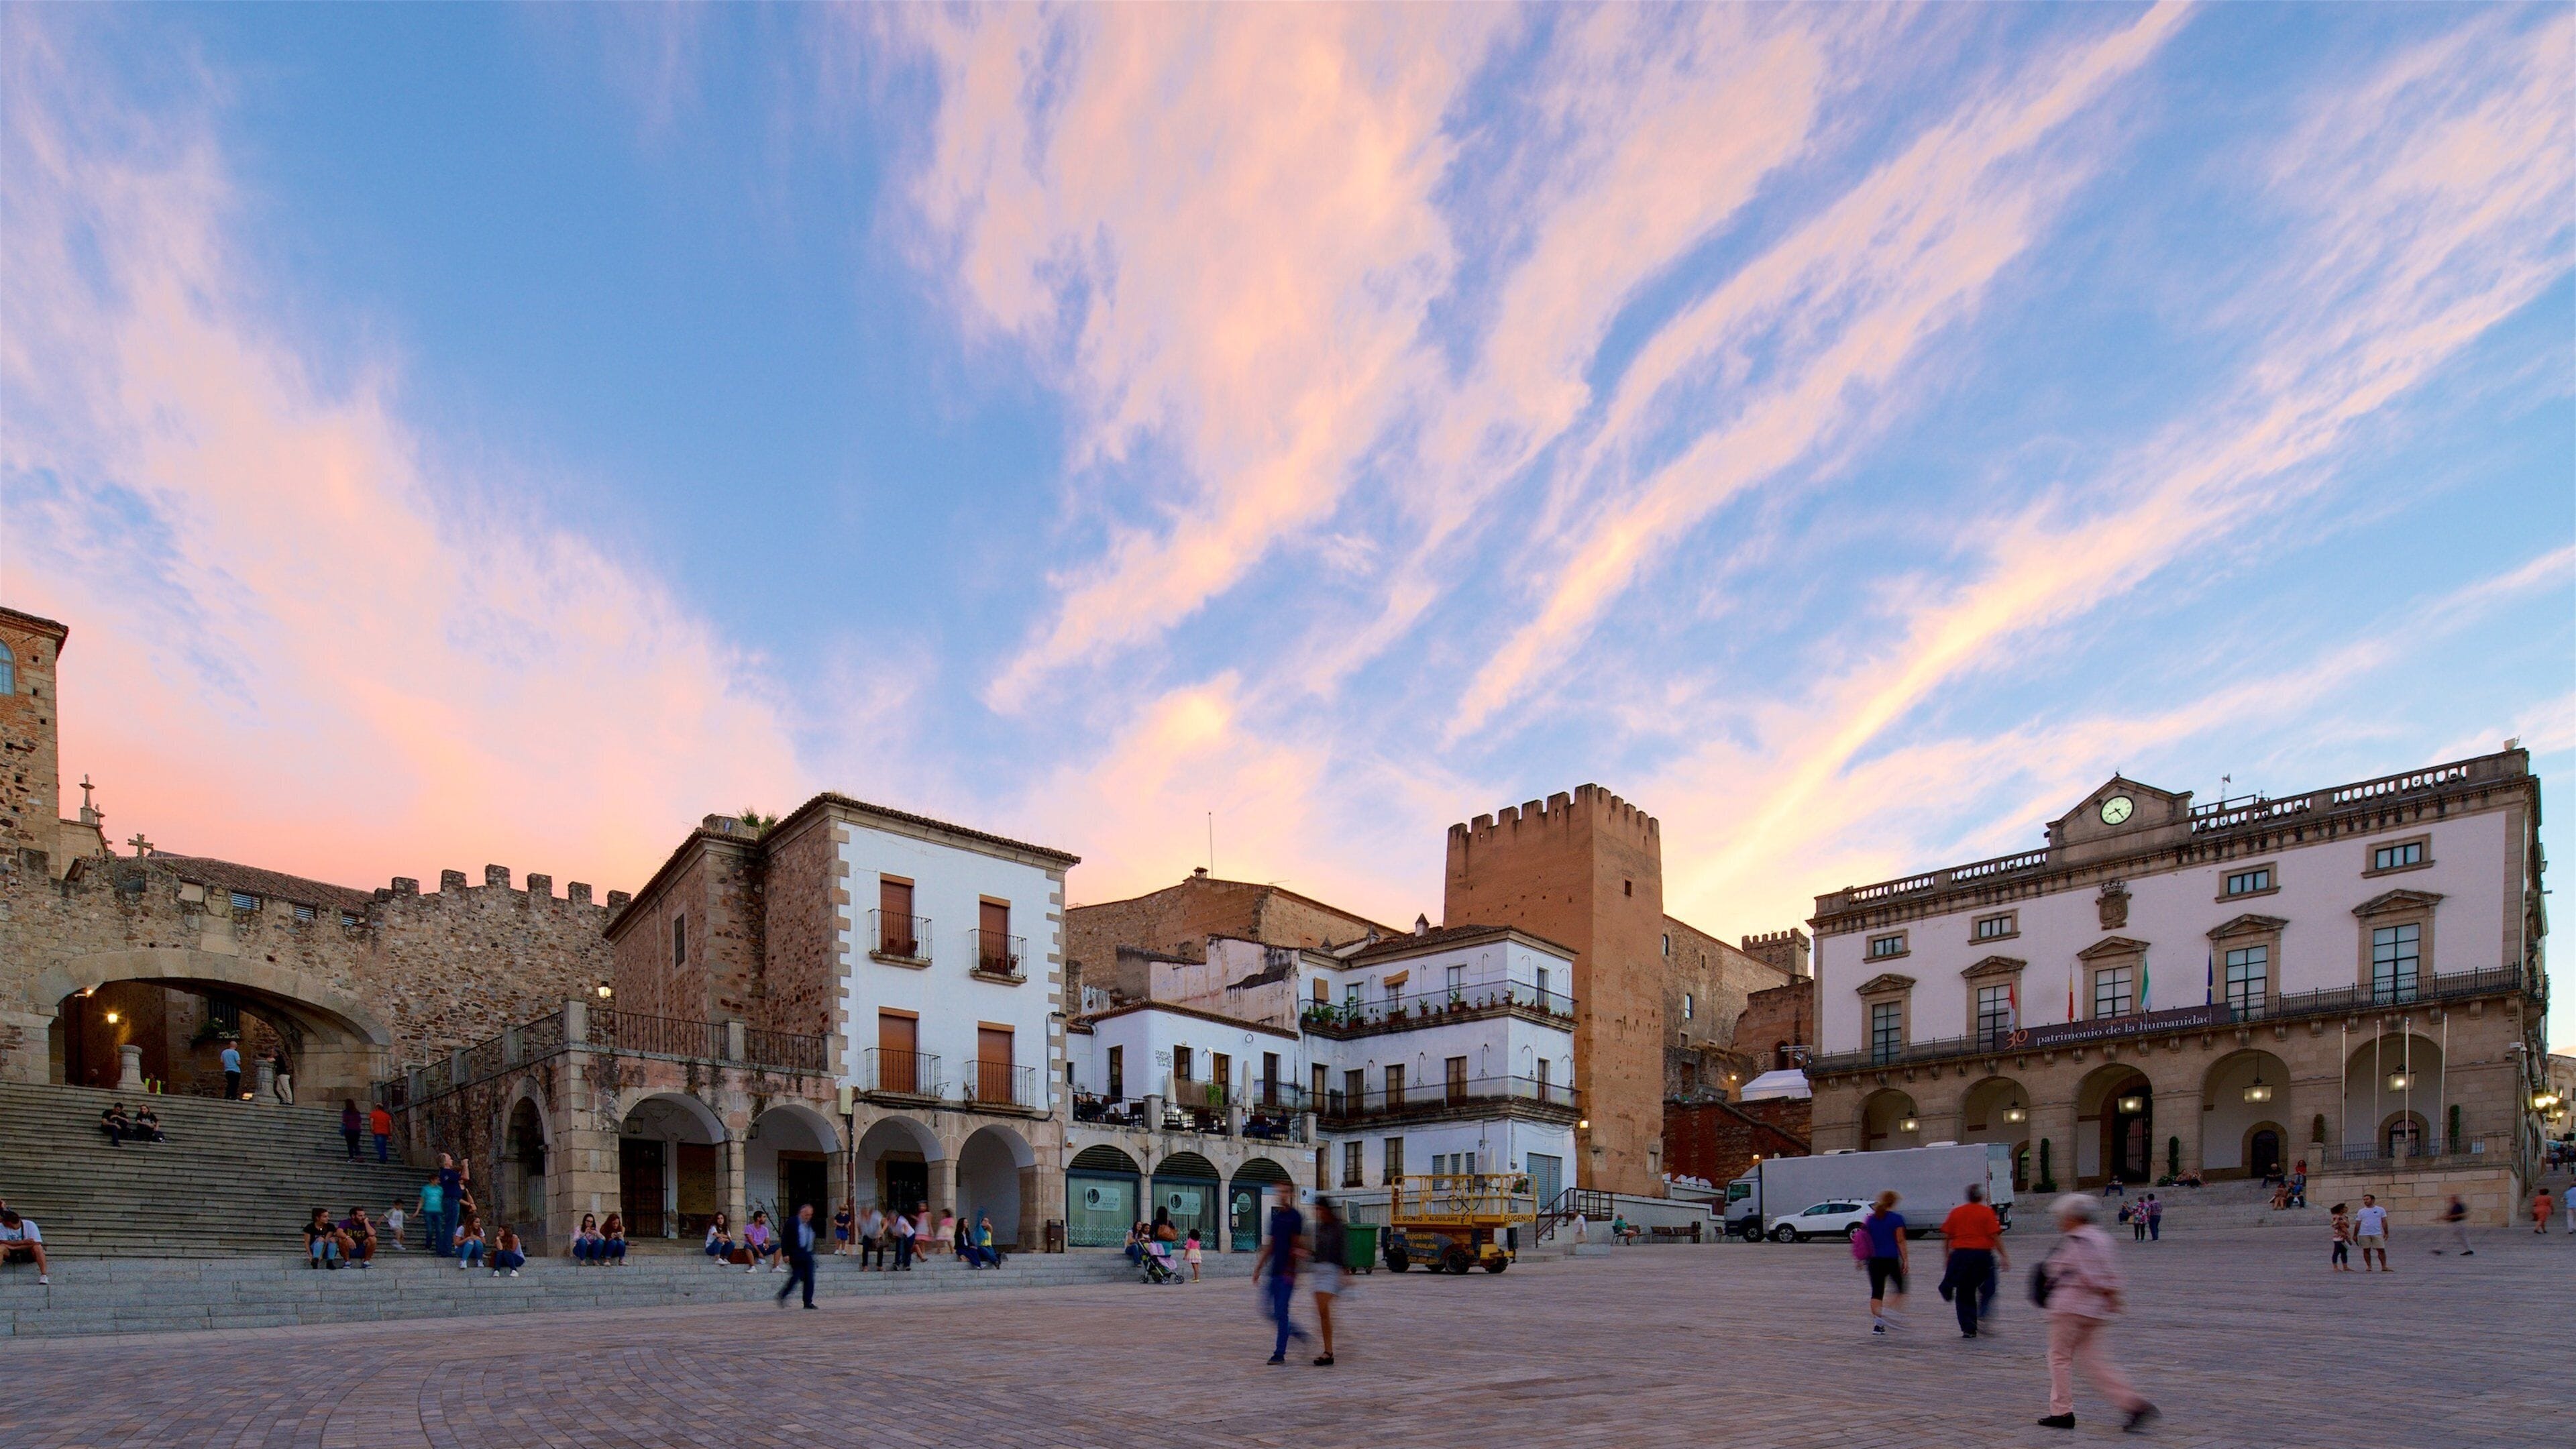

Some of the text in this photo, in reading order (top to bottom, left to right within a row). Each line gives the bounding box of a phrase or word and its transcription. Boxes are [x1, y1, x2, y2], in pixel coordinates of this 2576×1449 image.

[2004, 1029, 2029, 1050] 30
[2037, 1028, 2102, 1046] patrimonio
[2106, 1025, 2121, 1034] de
[2125, 1023, 2135, 1032] la
